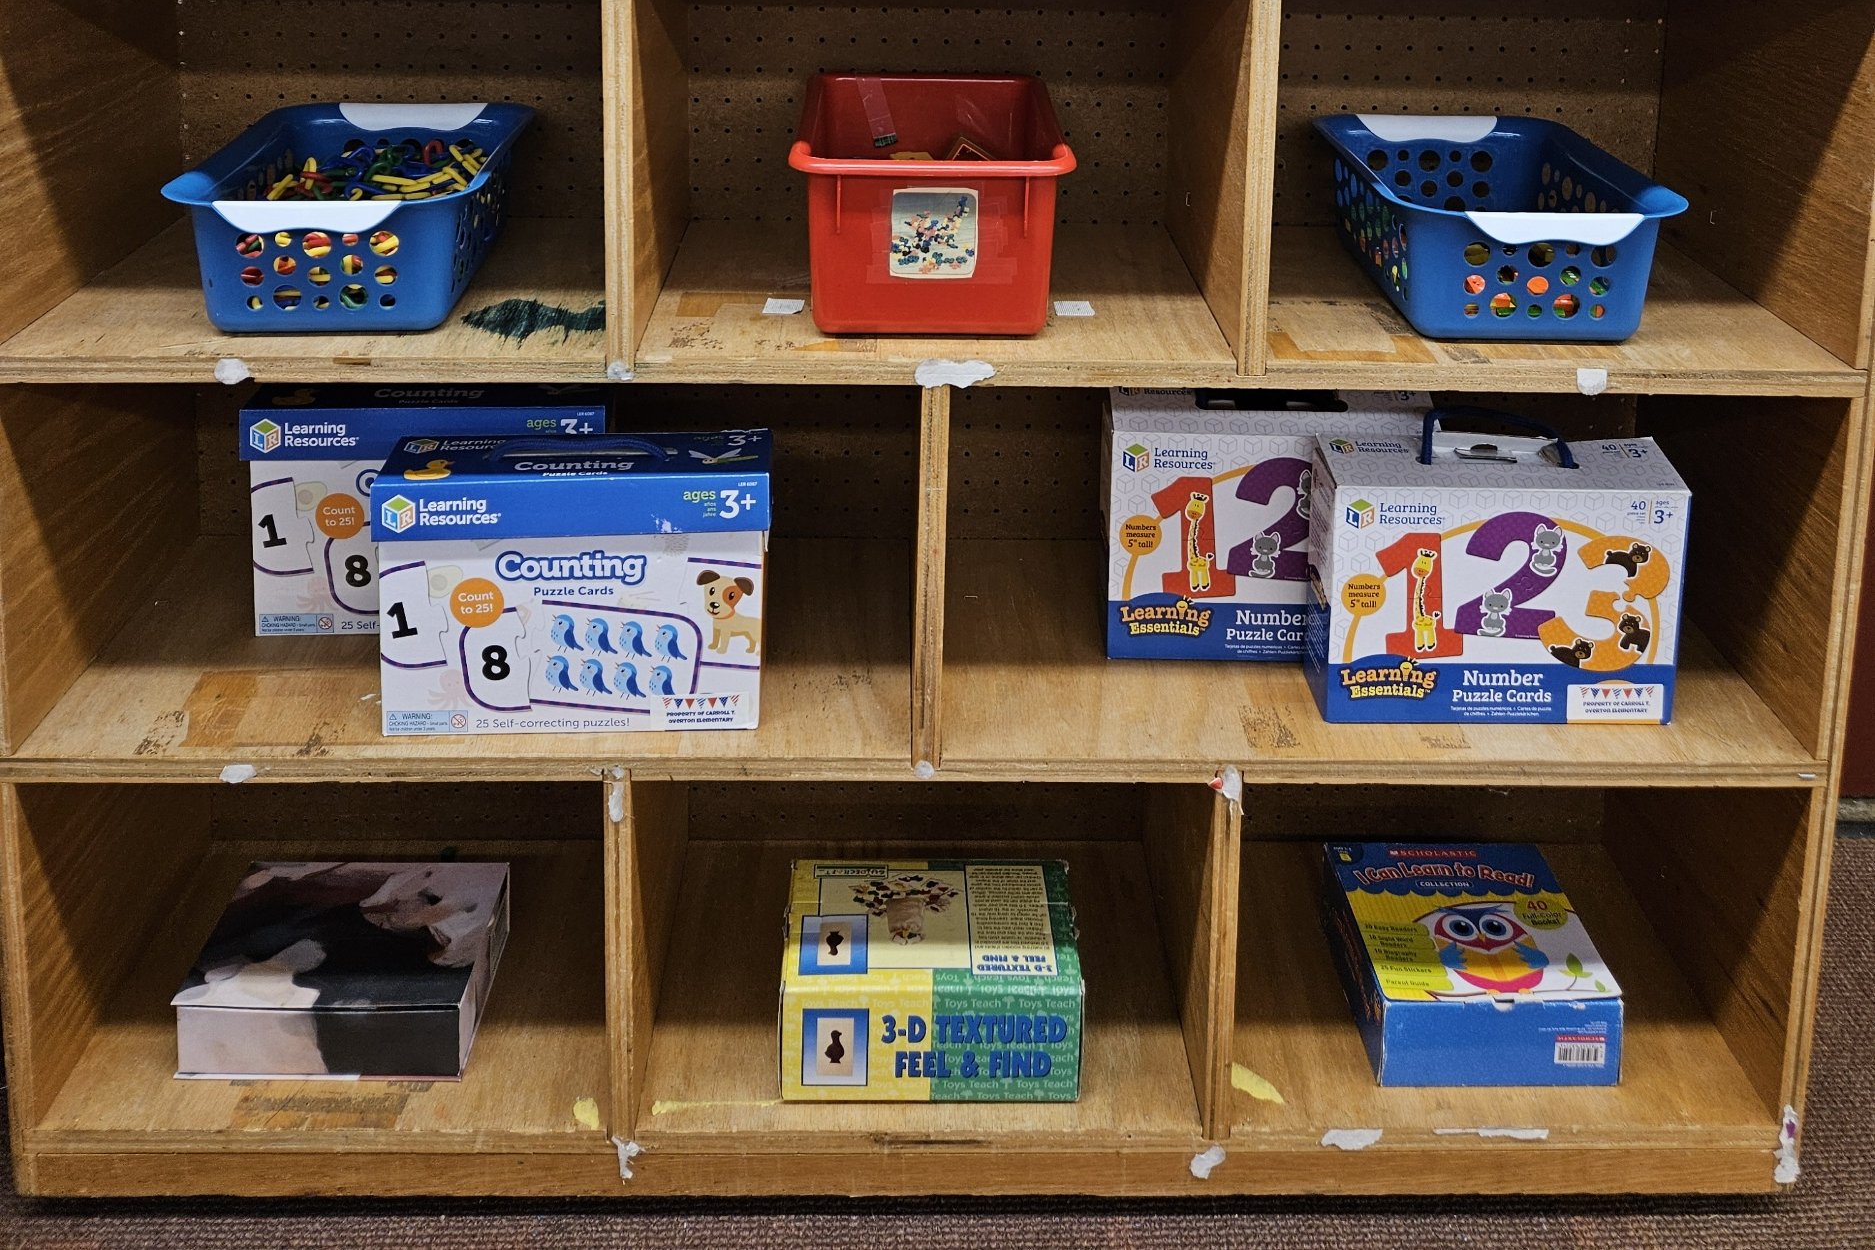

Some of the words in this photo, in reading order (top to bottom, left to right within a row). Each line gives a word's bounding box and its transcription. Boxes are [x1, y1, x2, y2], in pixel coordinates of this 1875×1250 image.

[284, 422, 346, 436] Learning
[526, 418, 557, 431] ages
[560, 418, 594, 434] 3+
[727, 434, 762, 446] 3+
[1355, 441, 1402, 449] Learning
[1154, 447, 1208, 460] Learning
[514, 460, 635, 471] Counting
[1154, 458, 1213, 470] Resources
[419, 497, 487, 513] Learning
[683, 490, 716, 503] ages
[719, 489, 757, 519] 3+
[1379, 503, 1437, 515] Learning
[322, 507, 356, 516] Count
[1631, 500, 1647, 510] 40
[1653, 509, 1674, 524] 3+
[325, 518, 337, 527] to
[339, 517, 355, 526] 25!
[1379, 514, 1443, 525] Resources
[258, 513, 288, 549] 1
[1138, 540, 1153, 548] tall!
[344, 554, 372, 588] 8
[496, 551, 646, 585] Counting
[457, 591, 494, 602] Count
[534, 586, 575, 596] Puzzle
[578, 586, 614, 596] Cards
[460, 605, 473, 615] to
[475, 603, 494, 613] 25!
[1361, 600, 1377, 608] tall!
[386, 601, 419, 639] 1
[1120, 601, 1212, 627] Learning
[341, 621, 354, 630] 25
[1129, 621, 1200, 636] Essentials
[1225, 628, 1273, 641] Puzzle
[1277, 629, 1303, 641] Car
[481, 644, 511, 681] 8
[1341, 662, 1437, 689] Learning
[1462, 669, 1544, 686] Number
[1350, 683, 1424, 698] Essentials
[1452, 688, 1503, 702] Puzzle
[1506, 688, 1552, 703] Cards
[475, 719, 489, 728] 25
[492, 718, 580, 729] Self-correcting
[583, 717, 630, 730] puzzles!
[1399, 850, 1477, 858] SCHOLASTIC
[1366, 866, 1401, 882] Can
[1397, 861, 1454, 878] Learn
[1454, 862, 1476, 878] to
[1478, 865, 1536, 889] Read!
[1527, 900, 1548, 910] 40
[982, 954, 1008, 963] FIND
[1011, 954, 1020, 963] &
[1022, 954, 1046, 963] FEEL
[976, 963, 1031, 972] TEXTURED
[1033, 964, 1053, 972] 3-D
[944, 999, 968, 1009] Toys
[970, 998, 1001, 1008] Teach
[1018, 999, 1042, 1009] Toys
[1045, 998, 1076, 1008] Teach
[881, 1014, 928, 1045] 3-D
[935, 1014, 1068, 1044] TEXTURED
[894, 1050, 952, 1079] FEEL
[960, 1050, 980, 1078] &
[988, 1050, 1052, 1079] FIND
[943, 1080, 966, 1090] Toys
[968, 1079, 999, 1089] Teach
[1016, 1080, 1040, 1090] Toys
[1043, 1079, 1073, 1089] Teach
[976, 1091, 1000, 1100] Toys
[1003, 1091, 1034, 1100] Teach
